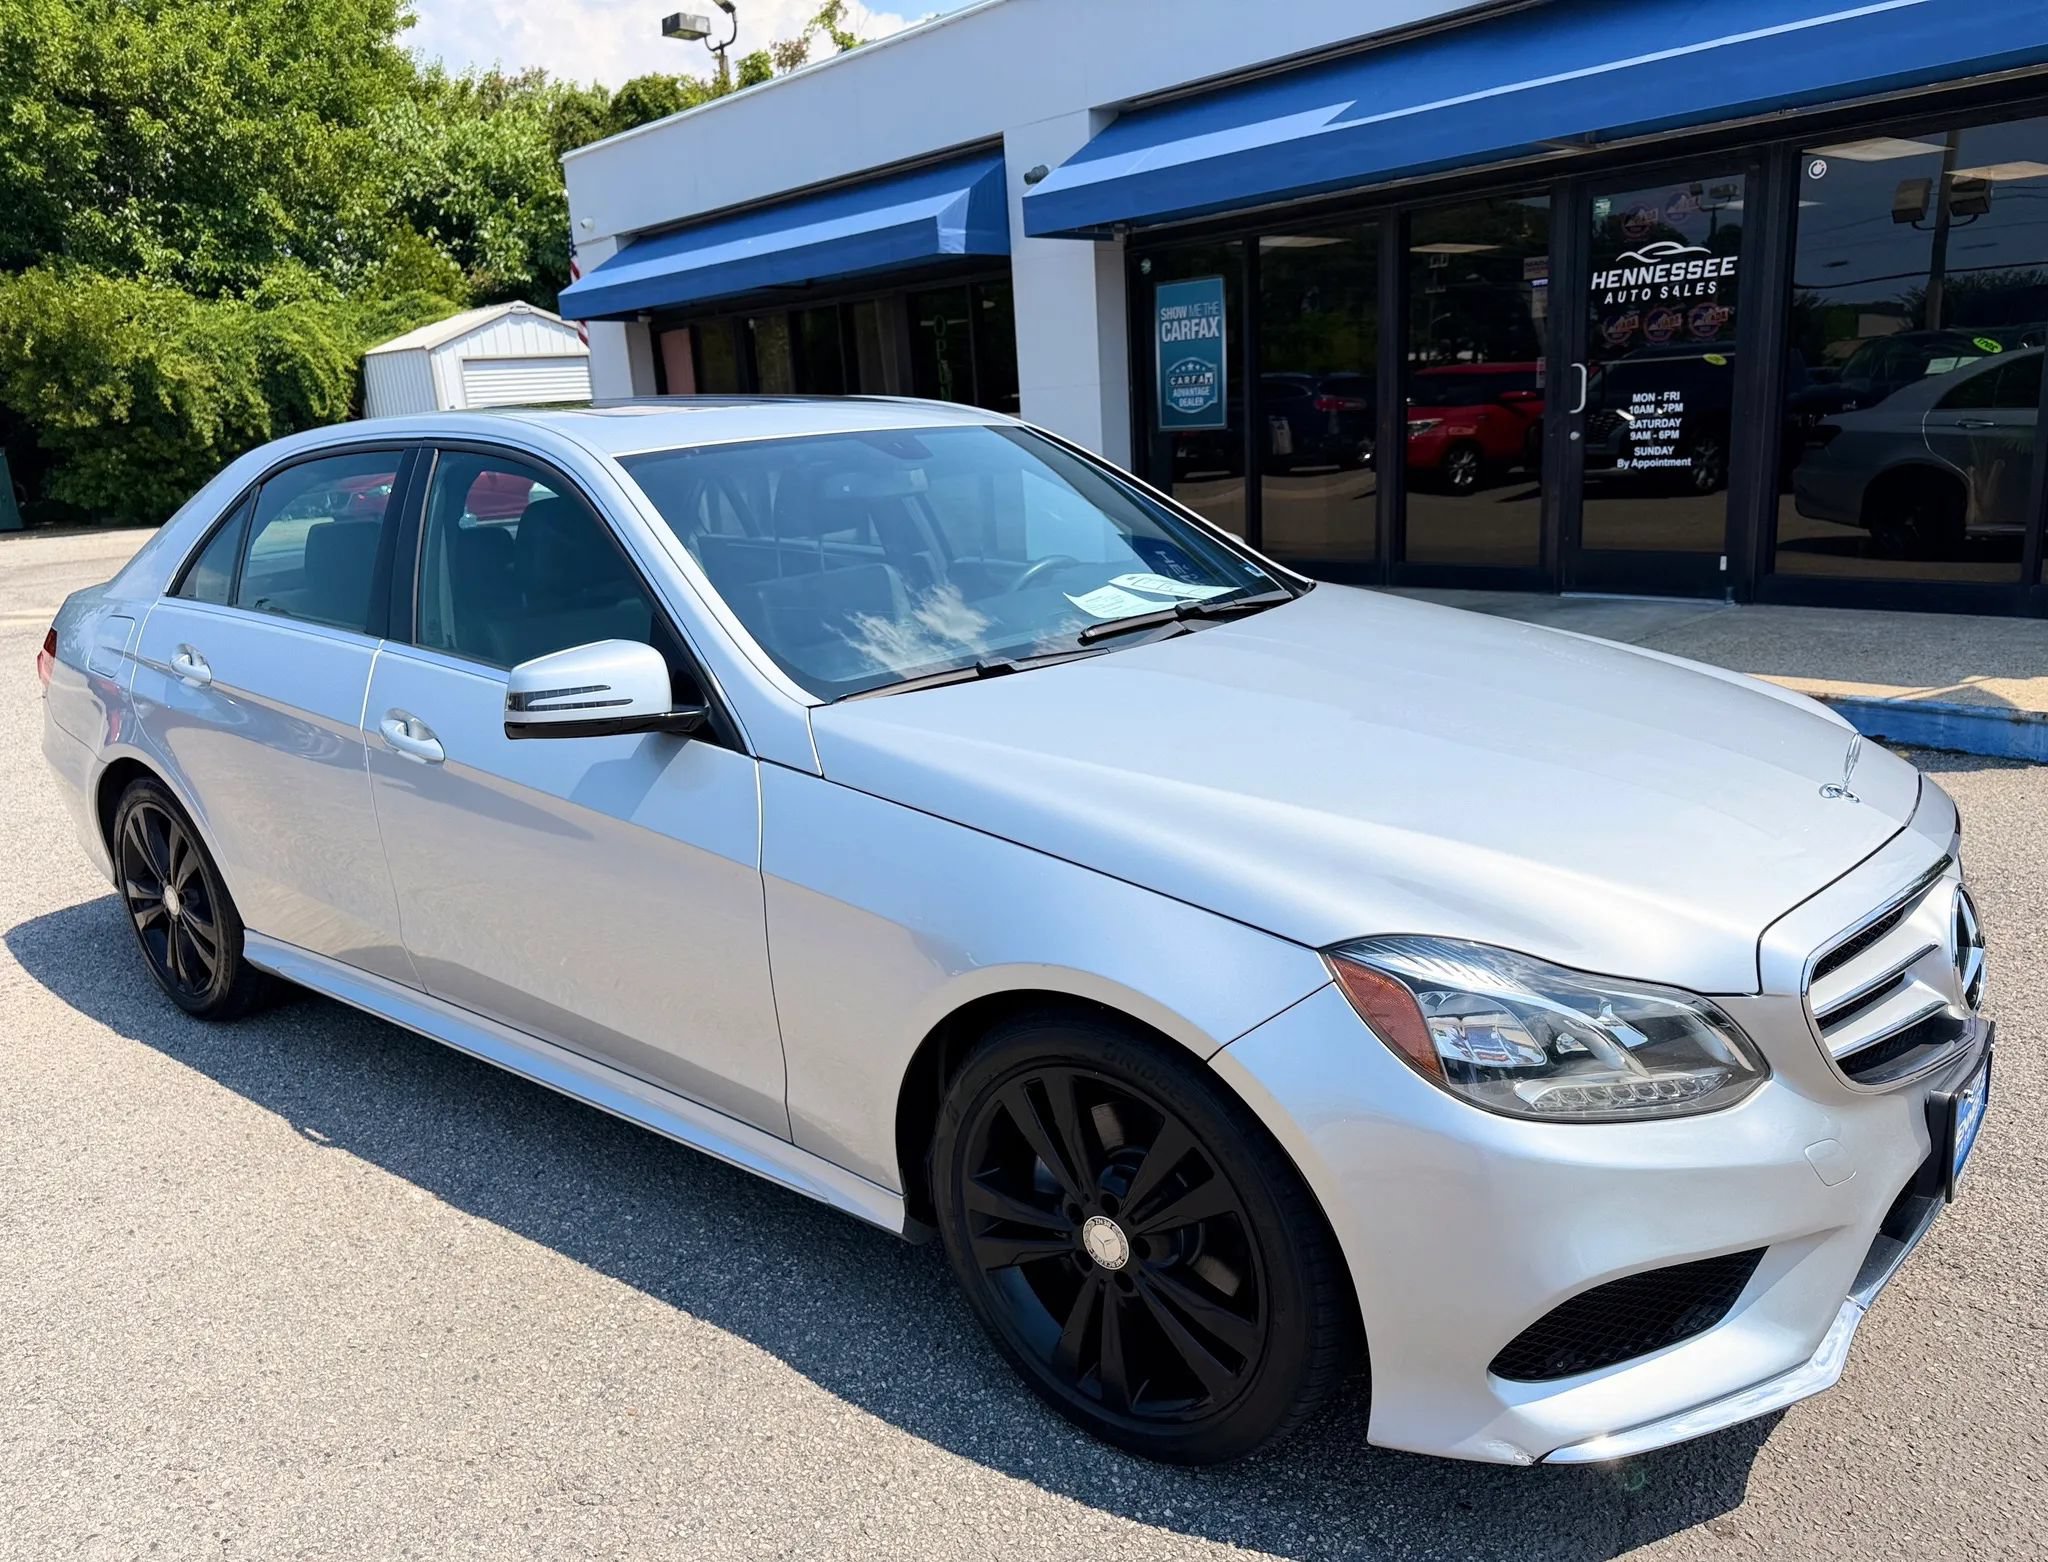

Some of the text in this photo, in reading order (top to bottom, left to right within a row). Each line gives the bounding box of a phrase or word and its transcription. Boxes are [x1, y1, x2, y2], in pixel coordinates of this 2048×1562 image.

[1591, 256, 1738, 290] HENNESSEE
[1604, 281, 1717, 305] AUTO SALES
[1160, 301, 1220, 321] SHOW ME THE
[1161, 316, 1220, 342] CARFAX
[1170, 373, 1214, 386] CARFAX
[1172, 386, 1211, 398] ADVANTAGE
[1632, 392, 1656, 403] MON
[1663, 391, 1680, 401] FRI
[1178, 397, 1204, 408] DEALER
[1628, 404, 1655, 415] 10AM
[1662, 403, 1684, 413] 7PM
[1628, 418, 1682, 429] SATURDAY
[1629, 431, 1651, 441] 9AM
[1658, 430, 1680, 440] 6PM
[1633, 445, 1675, 456] SUNDAY
[1616, 457, 1692, 470] By Appointment
